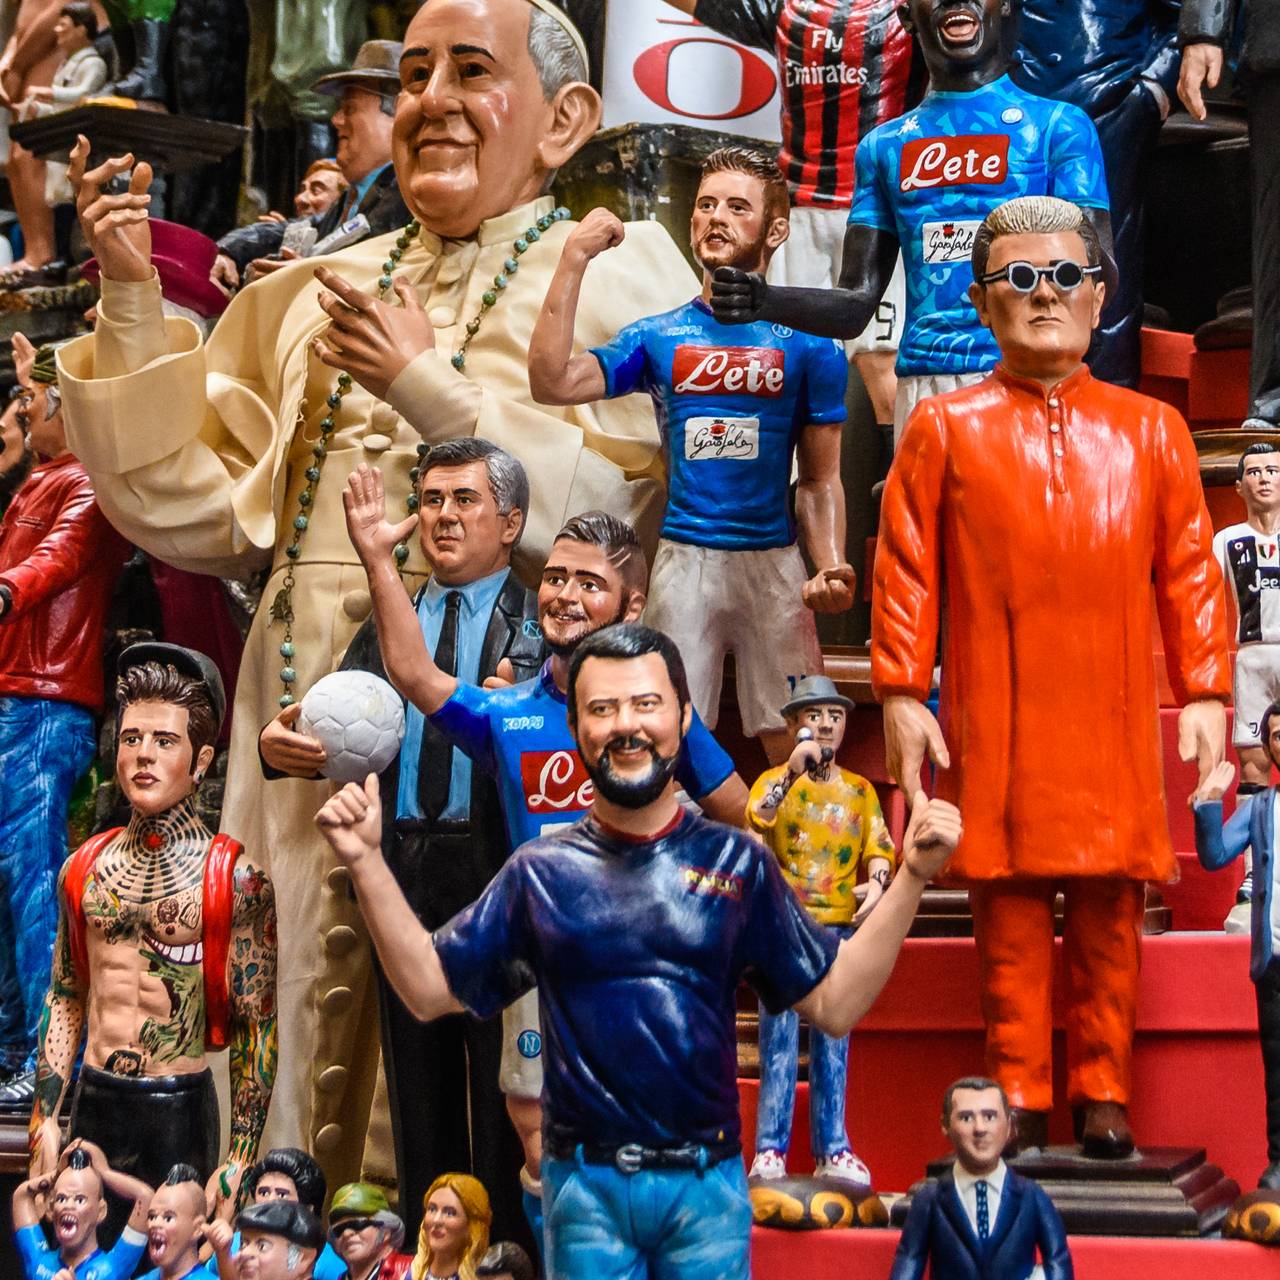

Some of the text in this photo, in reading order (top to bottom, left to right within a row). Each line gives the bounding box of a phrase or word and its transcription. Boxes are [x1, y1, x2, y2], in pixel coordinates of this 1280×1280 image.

[811, 29, 844, 53] Fly
[785, 61, 869, 88] Emirates
[901, 142, 1001, 191] Lete
[674, 351, 784, 393] Lete
[527, 751, 595, 808] Le
